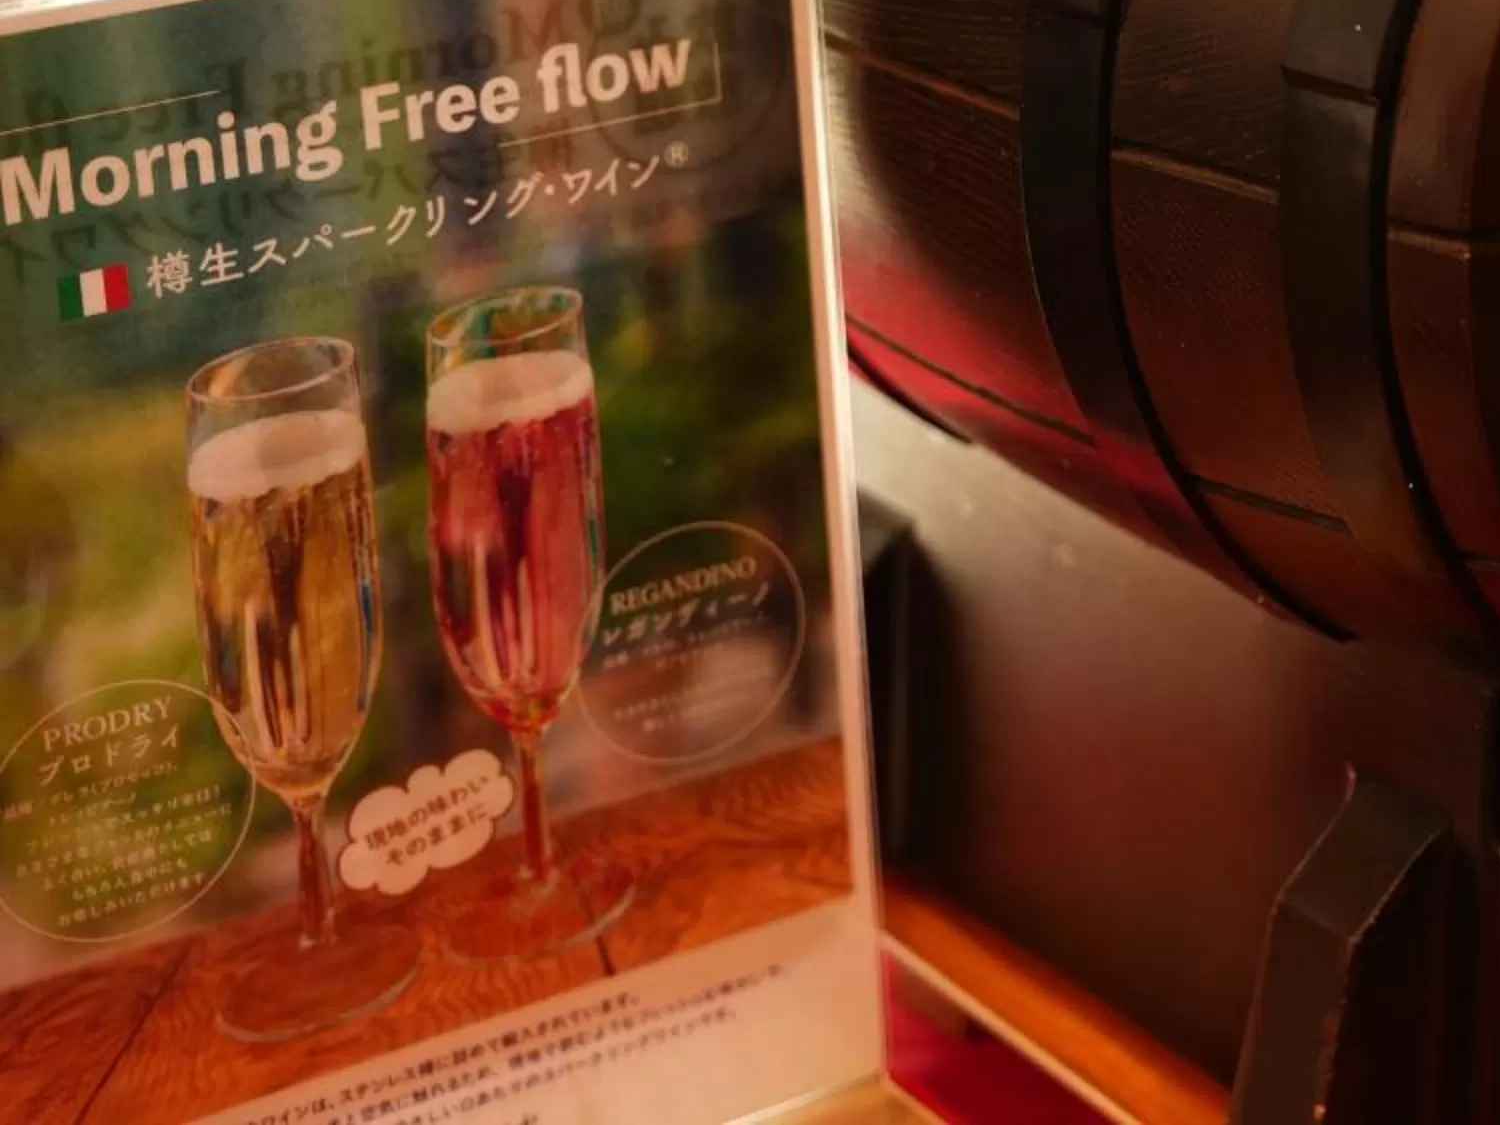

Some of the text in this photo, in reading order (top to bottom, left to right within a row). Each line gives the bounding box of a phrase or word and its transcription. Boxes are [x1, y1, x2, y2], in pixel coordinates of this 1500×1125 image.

[2, 36, 692, 226] Morning Free flow
[610, 557, 758, 616] REGANDINO
[40, 722, 180, 787] プロドライ
[43, 695, 172, 752] PRODRY
